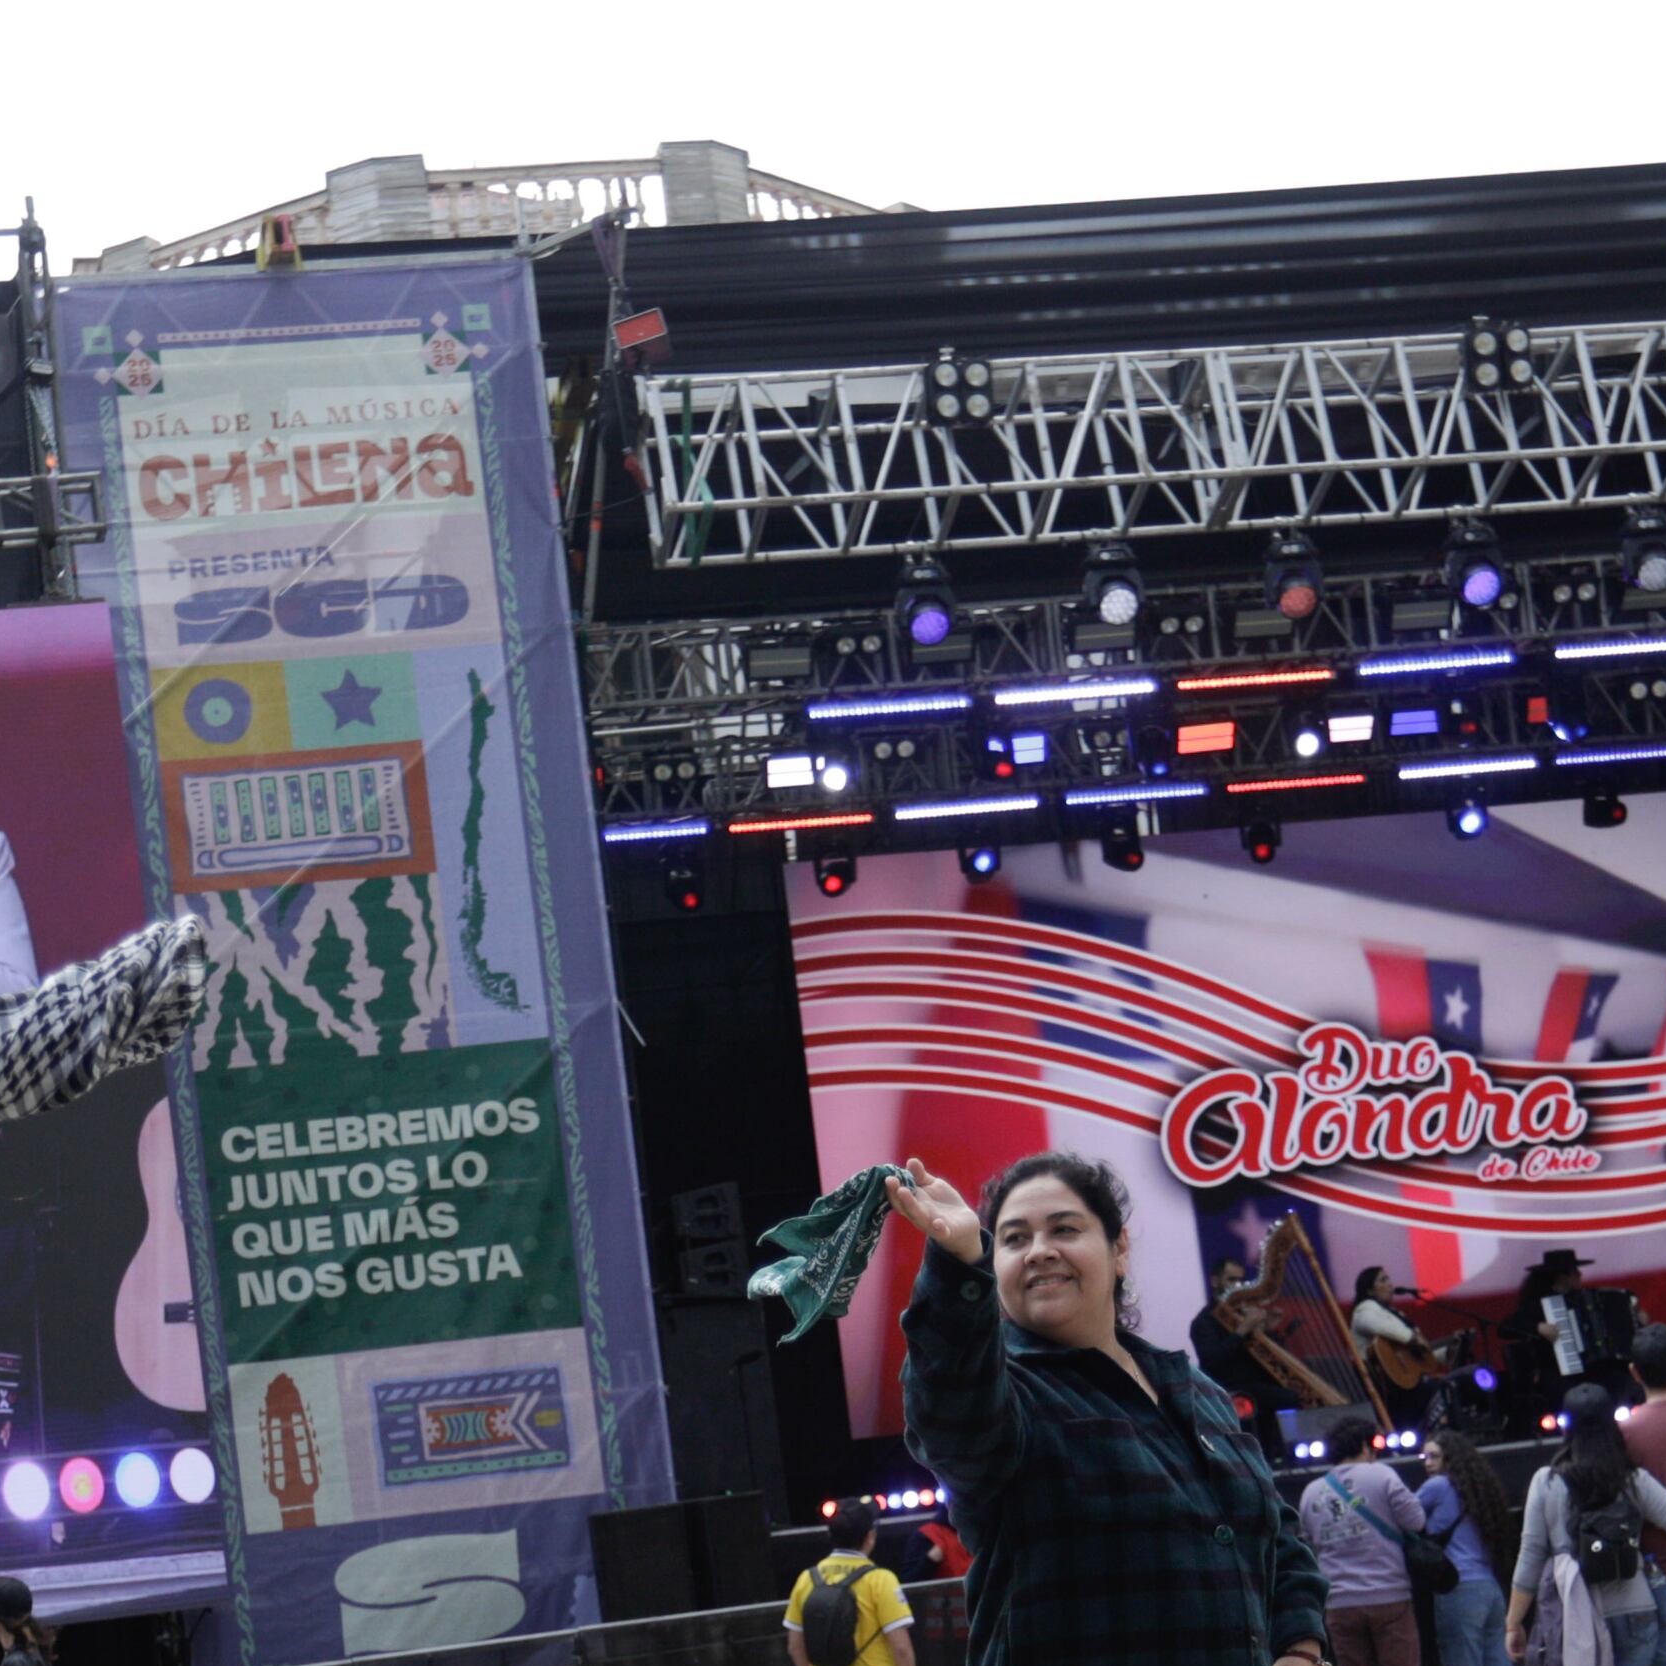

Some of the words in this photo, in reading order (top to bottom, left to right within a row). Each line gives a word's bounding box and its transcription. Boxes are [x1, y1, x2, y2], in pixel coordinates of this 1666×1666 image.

[433, 353, 457, 367] 25
[133, 413, 191, 441] DÍA
[212, 413, 251, 435] DE
[271, 408, 309, 430] LA
[326, 397, 460, 426] MÚSICA
[168, 546, 335, 580] PRESENTA
[1297, 1022, 1436, 1096] Duo
[221, 1097, 540, 1163] CELEBREMOS
[1161, 1051, 1588, 1188] Alondra
[227, 1158, 418, 1212] JUNTOS
[426, 1151, 489, 1190] LO
[1478, 1154, 1515, 1183] de
[1523, 1145, 1602, 1183] Chile
[232, 1215, 335, 1259] QUE
[343, 1196, 460, 1248] MÁS
[237, 1262, 348, 1308] NOS
[355, 1243, 524, 1295] GUSTA
